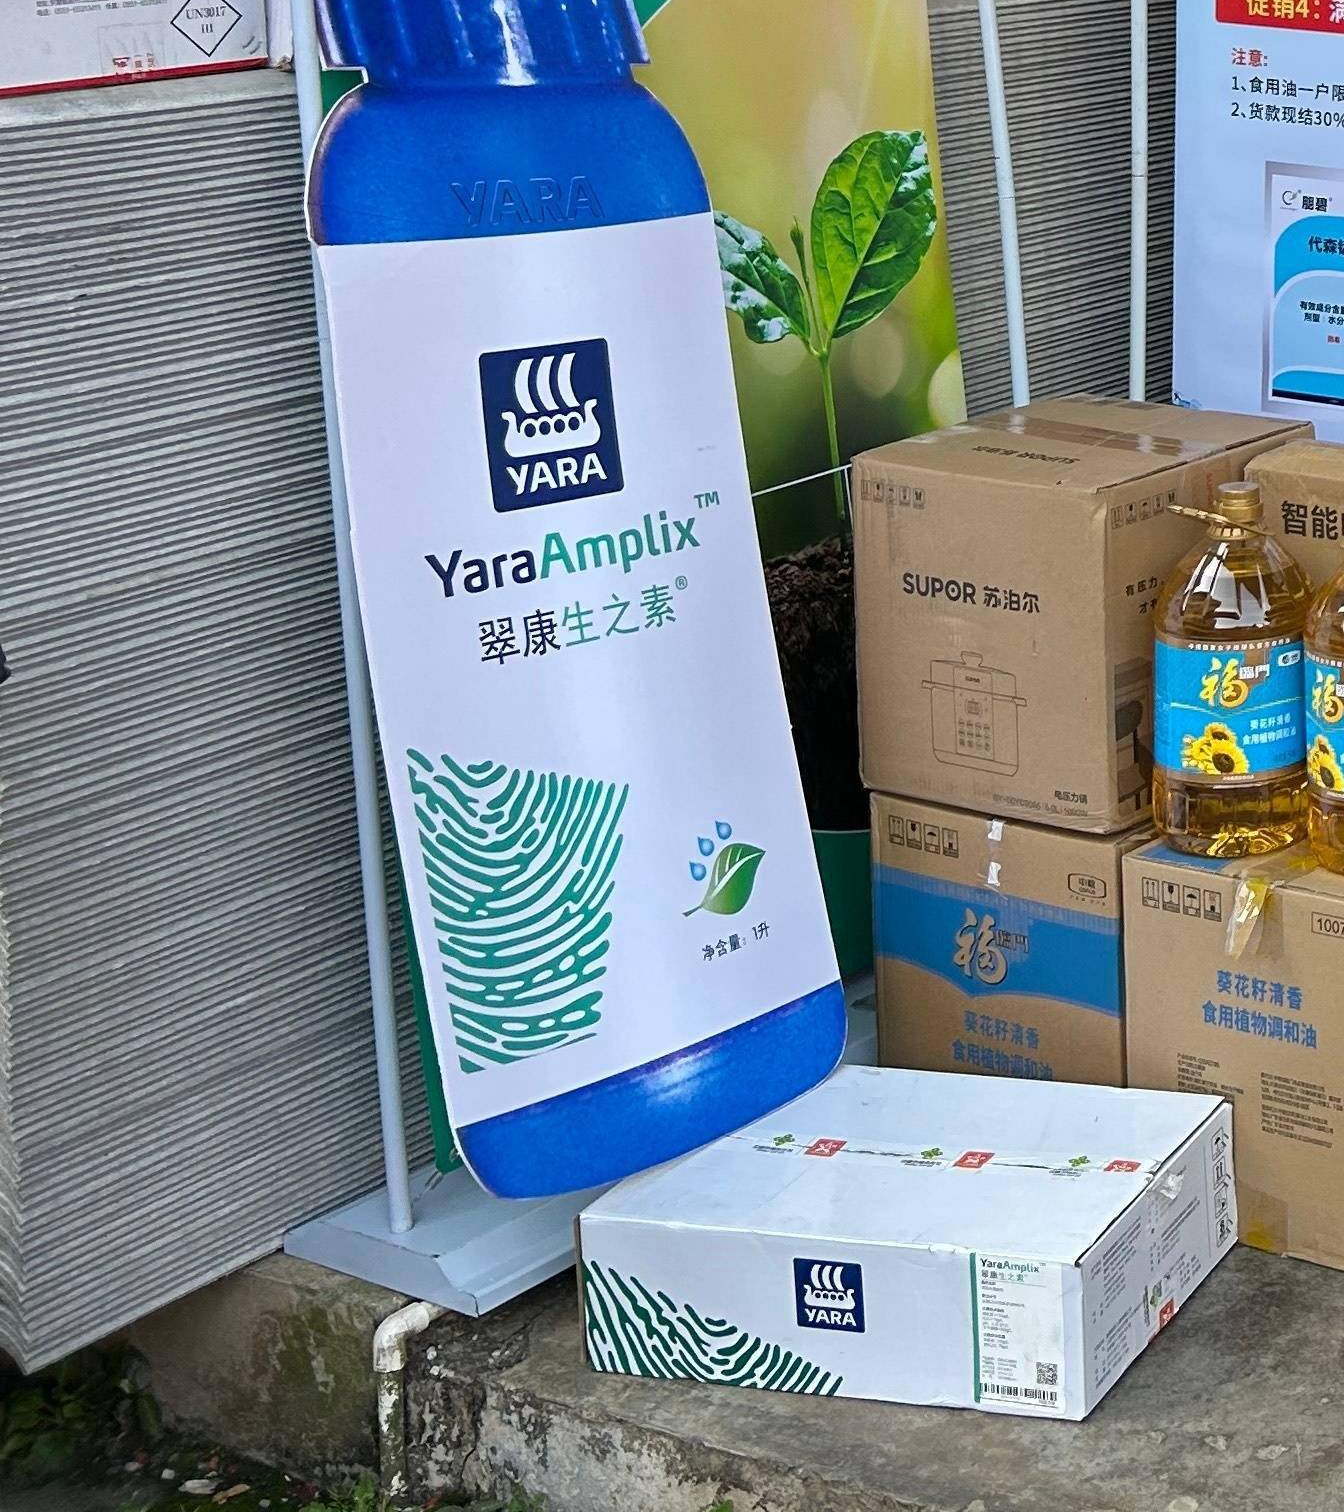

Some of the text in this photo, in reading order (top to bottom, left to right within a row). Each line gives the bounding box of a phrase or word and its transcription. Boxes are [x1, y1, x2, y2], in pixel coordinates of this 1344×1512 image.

[450, 175, 606, 226] YARA
[1301, 193, 1328, 213] 朋碧
[506, 453, 607, 495] YARA
[902, 572, 1041, 614] SUPOR 苏泊尔
[477, 583, 677, 666] 翠康生之素
[1054, 790, 1088, 804] 电压力锅
[1217, 970, 1304, 1011] 葵花籽清香
[963, 1011, 1040, 1048] 葵花籽清香
[1202, 1000, 1318, 1050] 食用植物调和油
[980, 1258, 1040, 1273] YaraAmplix
[804, 1307, 858, 1327] YARA
